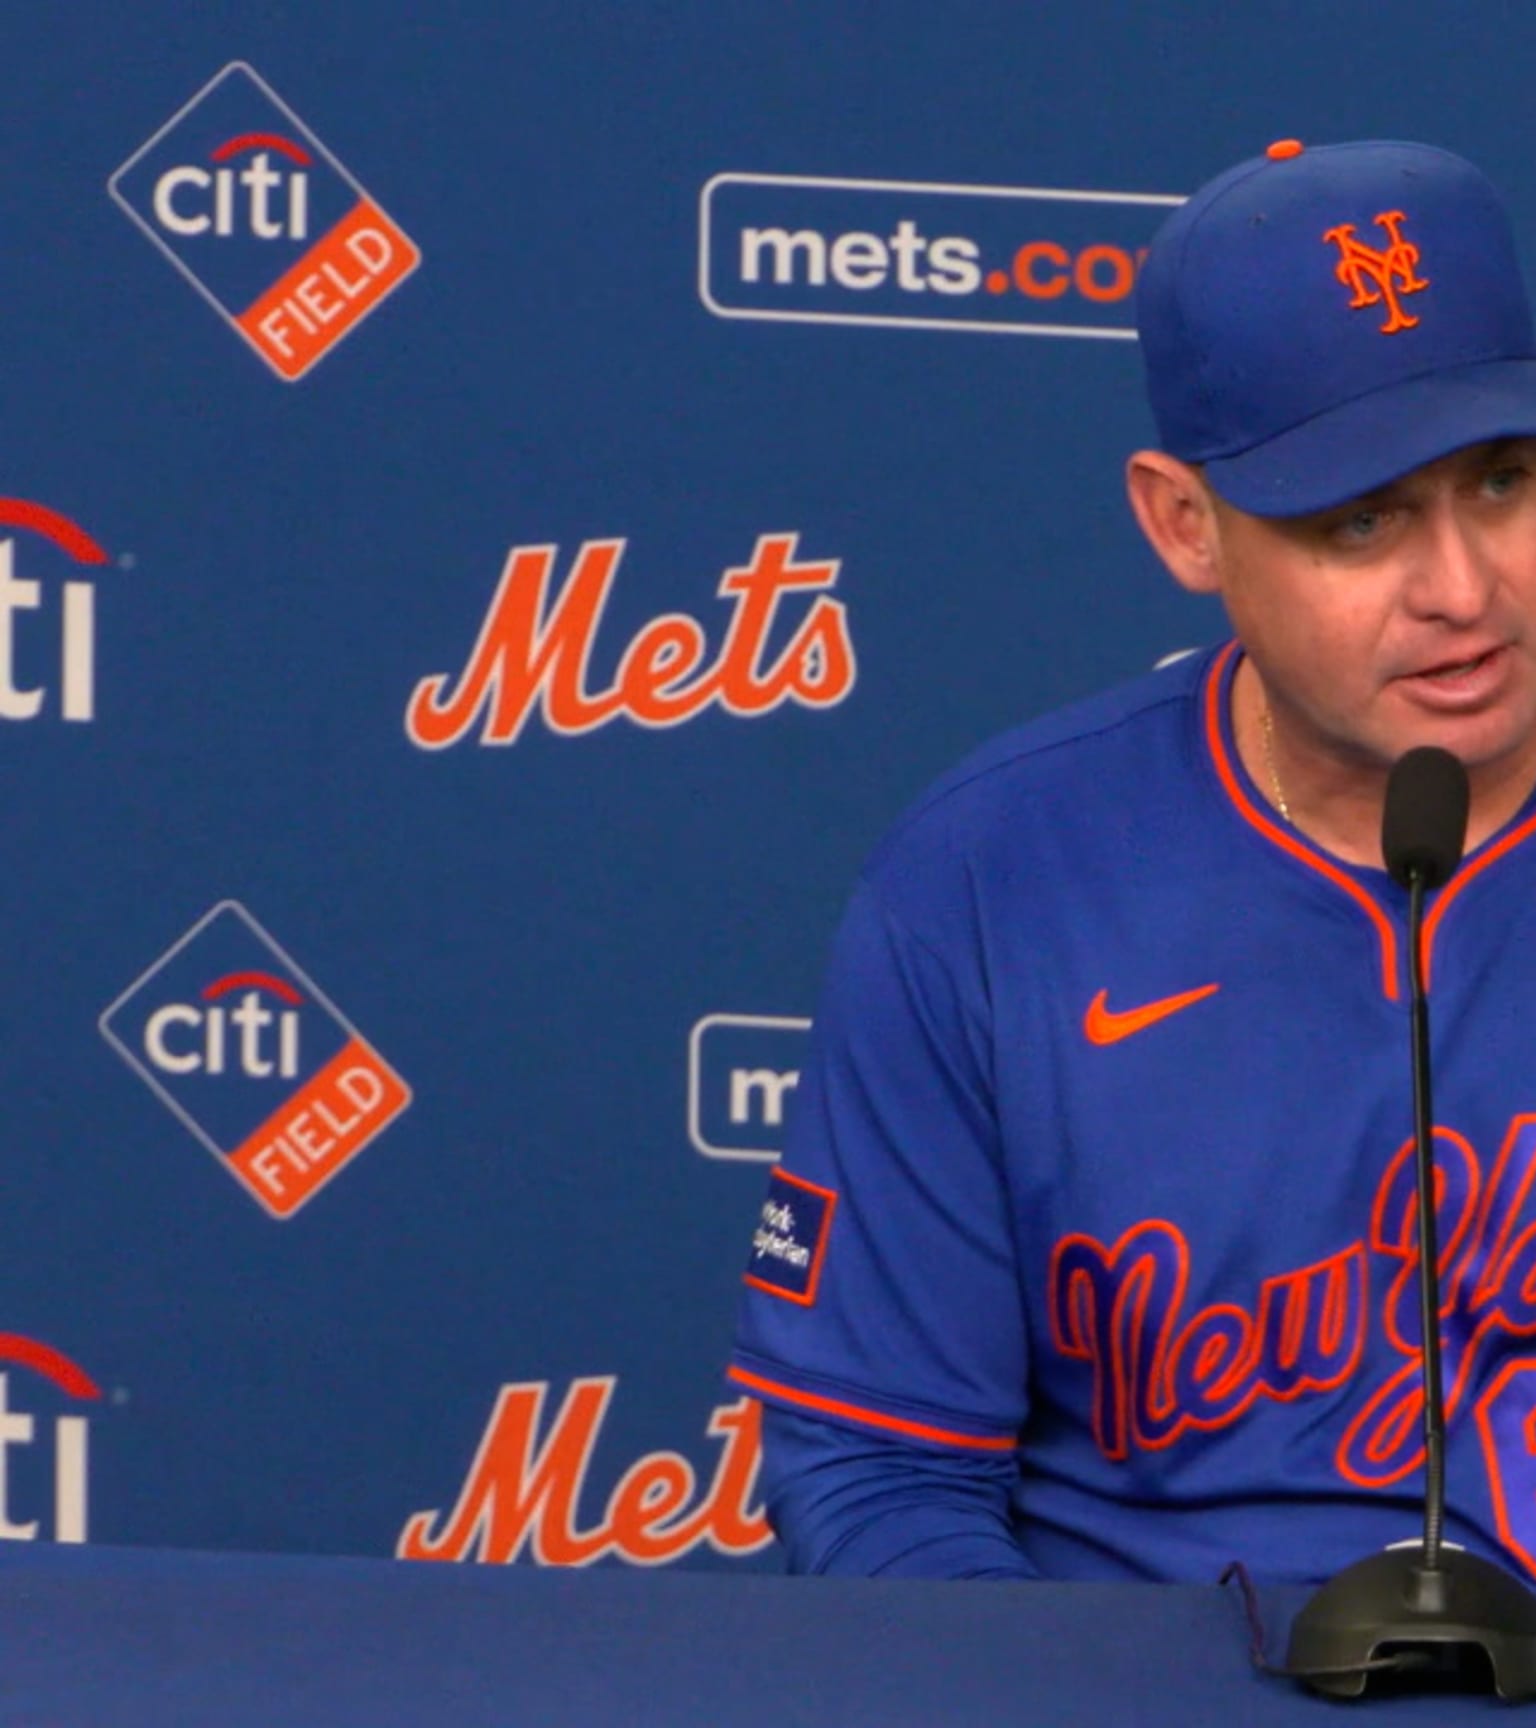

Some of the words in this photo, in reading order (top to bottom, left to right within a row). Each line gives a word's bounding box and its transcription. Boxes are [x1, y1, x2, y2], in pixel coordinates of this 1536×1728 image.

[153, 153, 307, 240] citi
[739, 220, 1149, 303] mets.co
[258, 227, 394, 359] FIELD
[405, 531, 857, 751] Mets
[144, 992, 299, 1079] citi
[250, 1066, 385, 1197] FIELD
[1050, 1217, 1369, 1461] New
